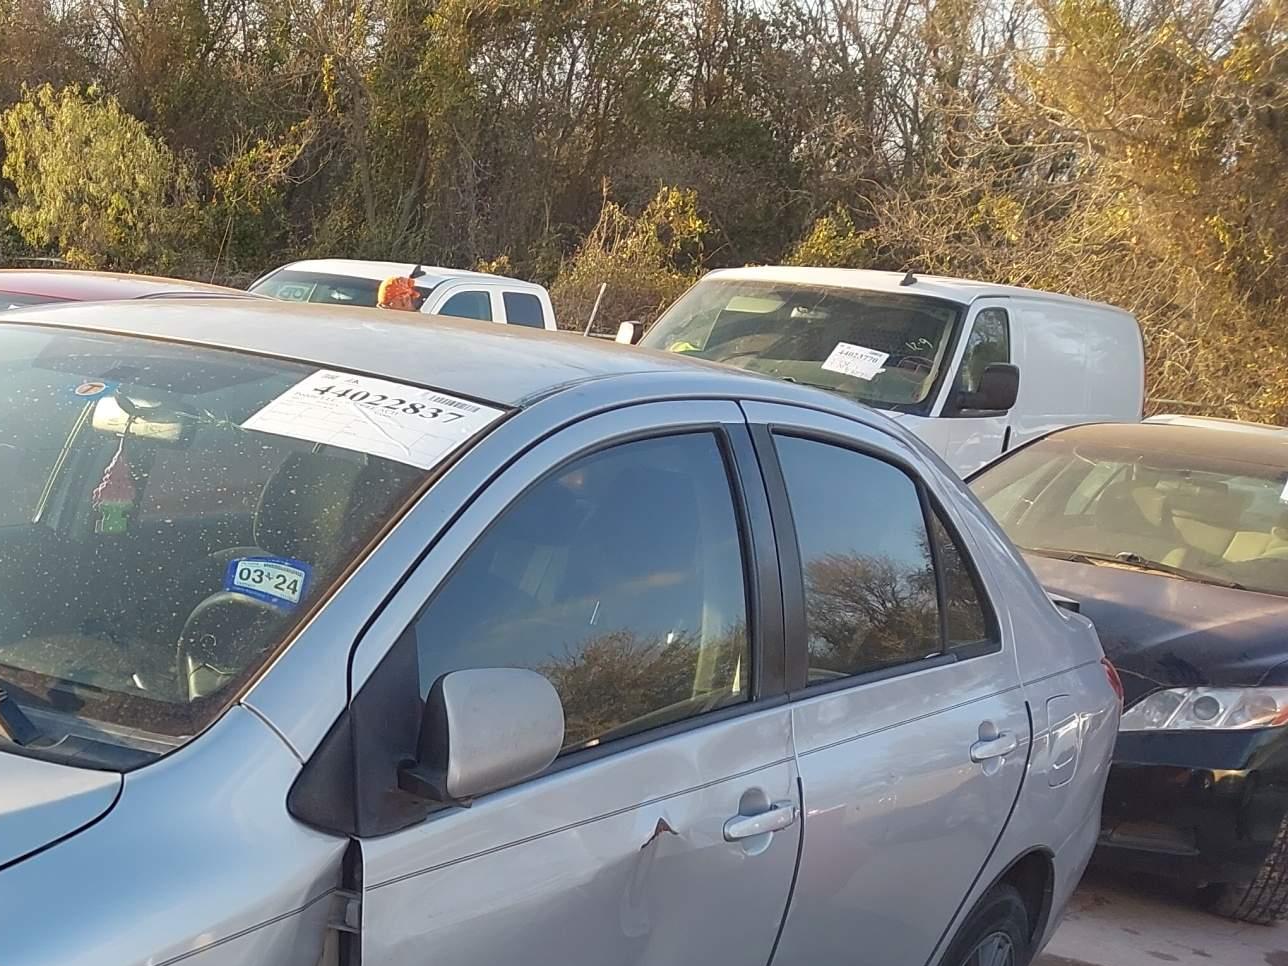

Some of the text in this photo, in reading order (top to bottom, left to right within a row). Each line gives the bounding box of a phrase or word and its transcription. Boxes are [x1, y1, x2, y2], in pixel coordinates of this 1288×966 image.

[313, 385, 465, 423] 44022837
[238, 567, 265, 584] 03
[273, 574, 299, 595] 24
